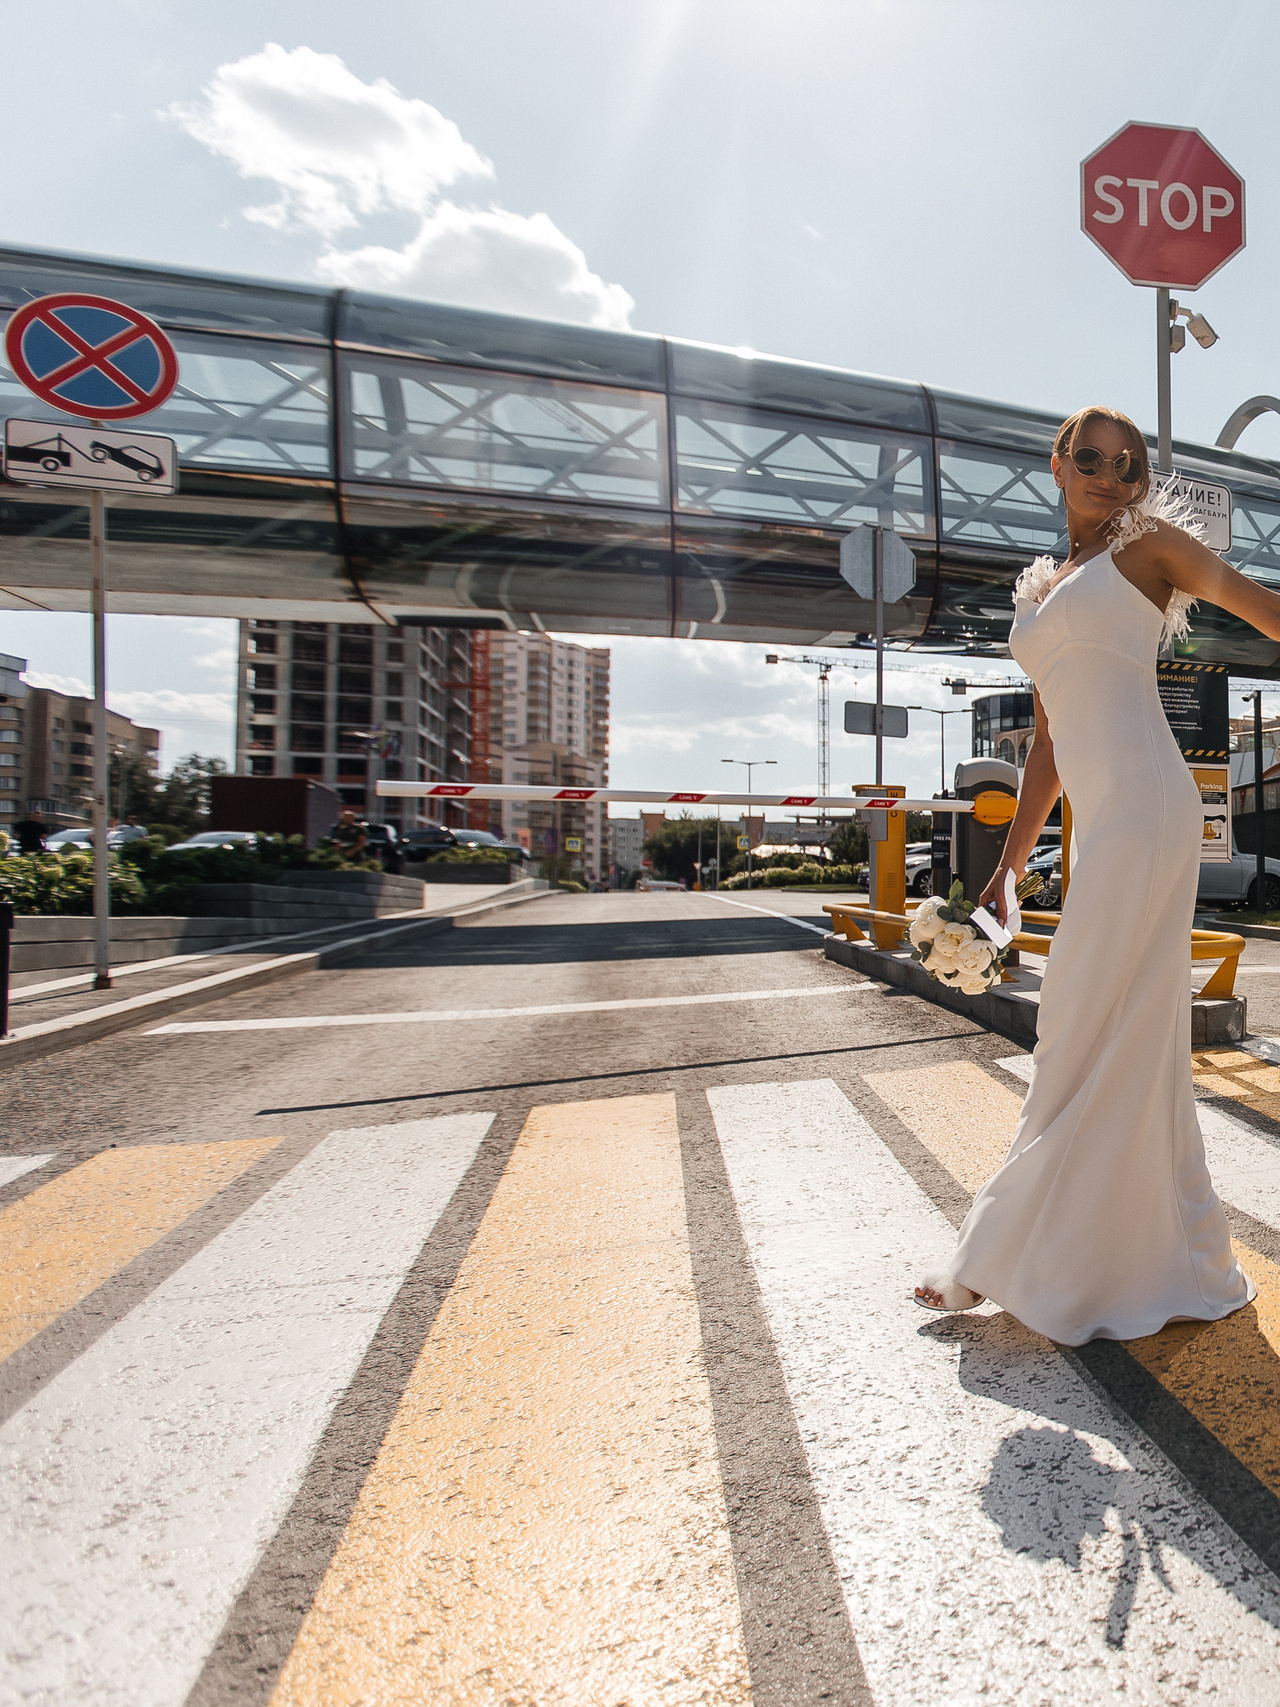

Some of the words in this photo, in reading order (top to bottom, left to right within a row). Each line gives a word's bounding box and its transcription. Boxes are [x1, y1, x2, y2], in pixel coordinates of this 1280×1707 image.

[1092, 174, 1235, 233] STOP
[1150, 480, 1221, 507] МАНИЕ!
[1200, 782, 1223, 791] Parking
